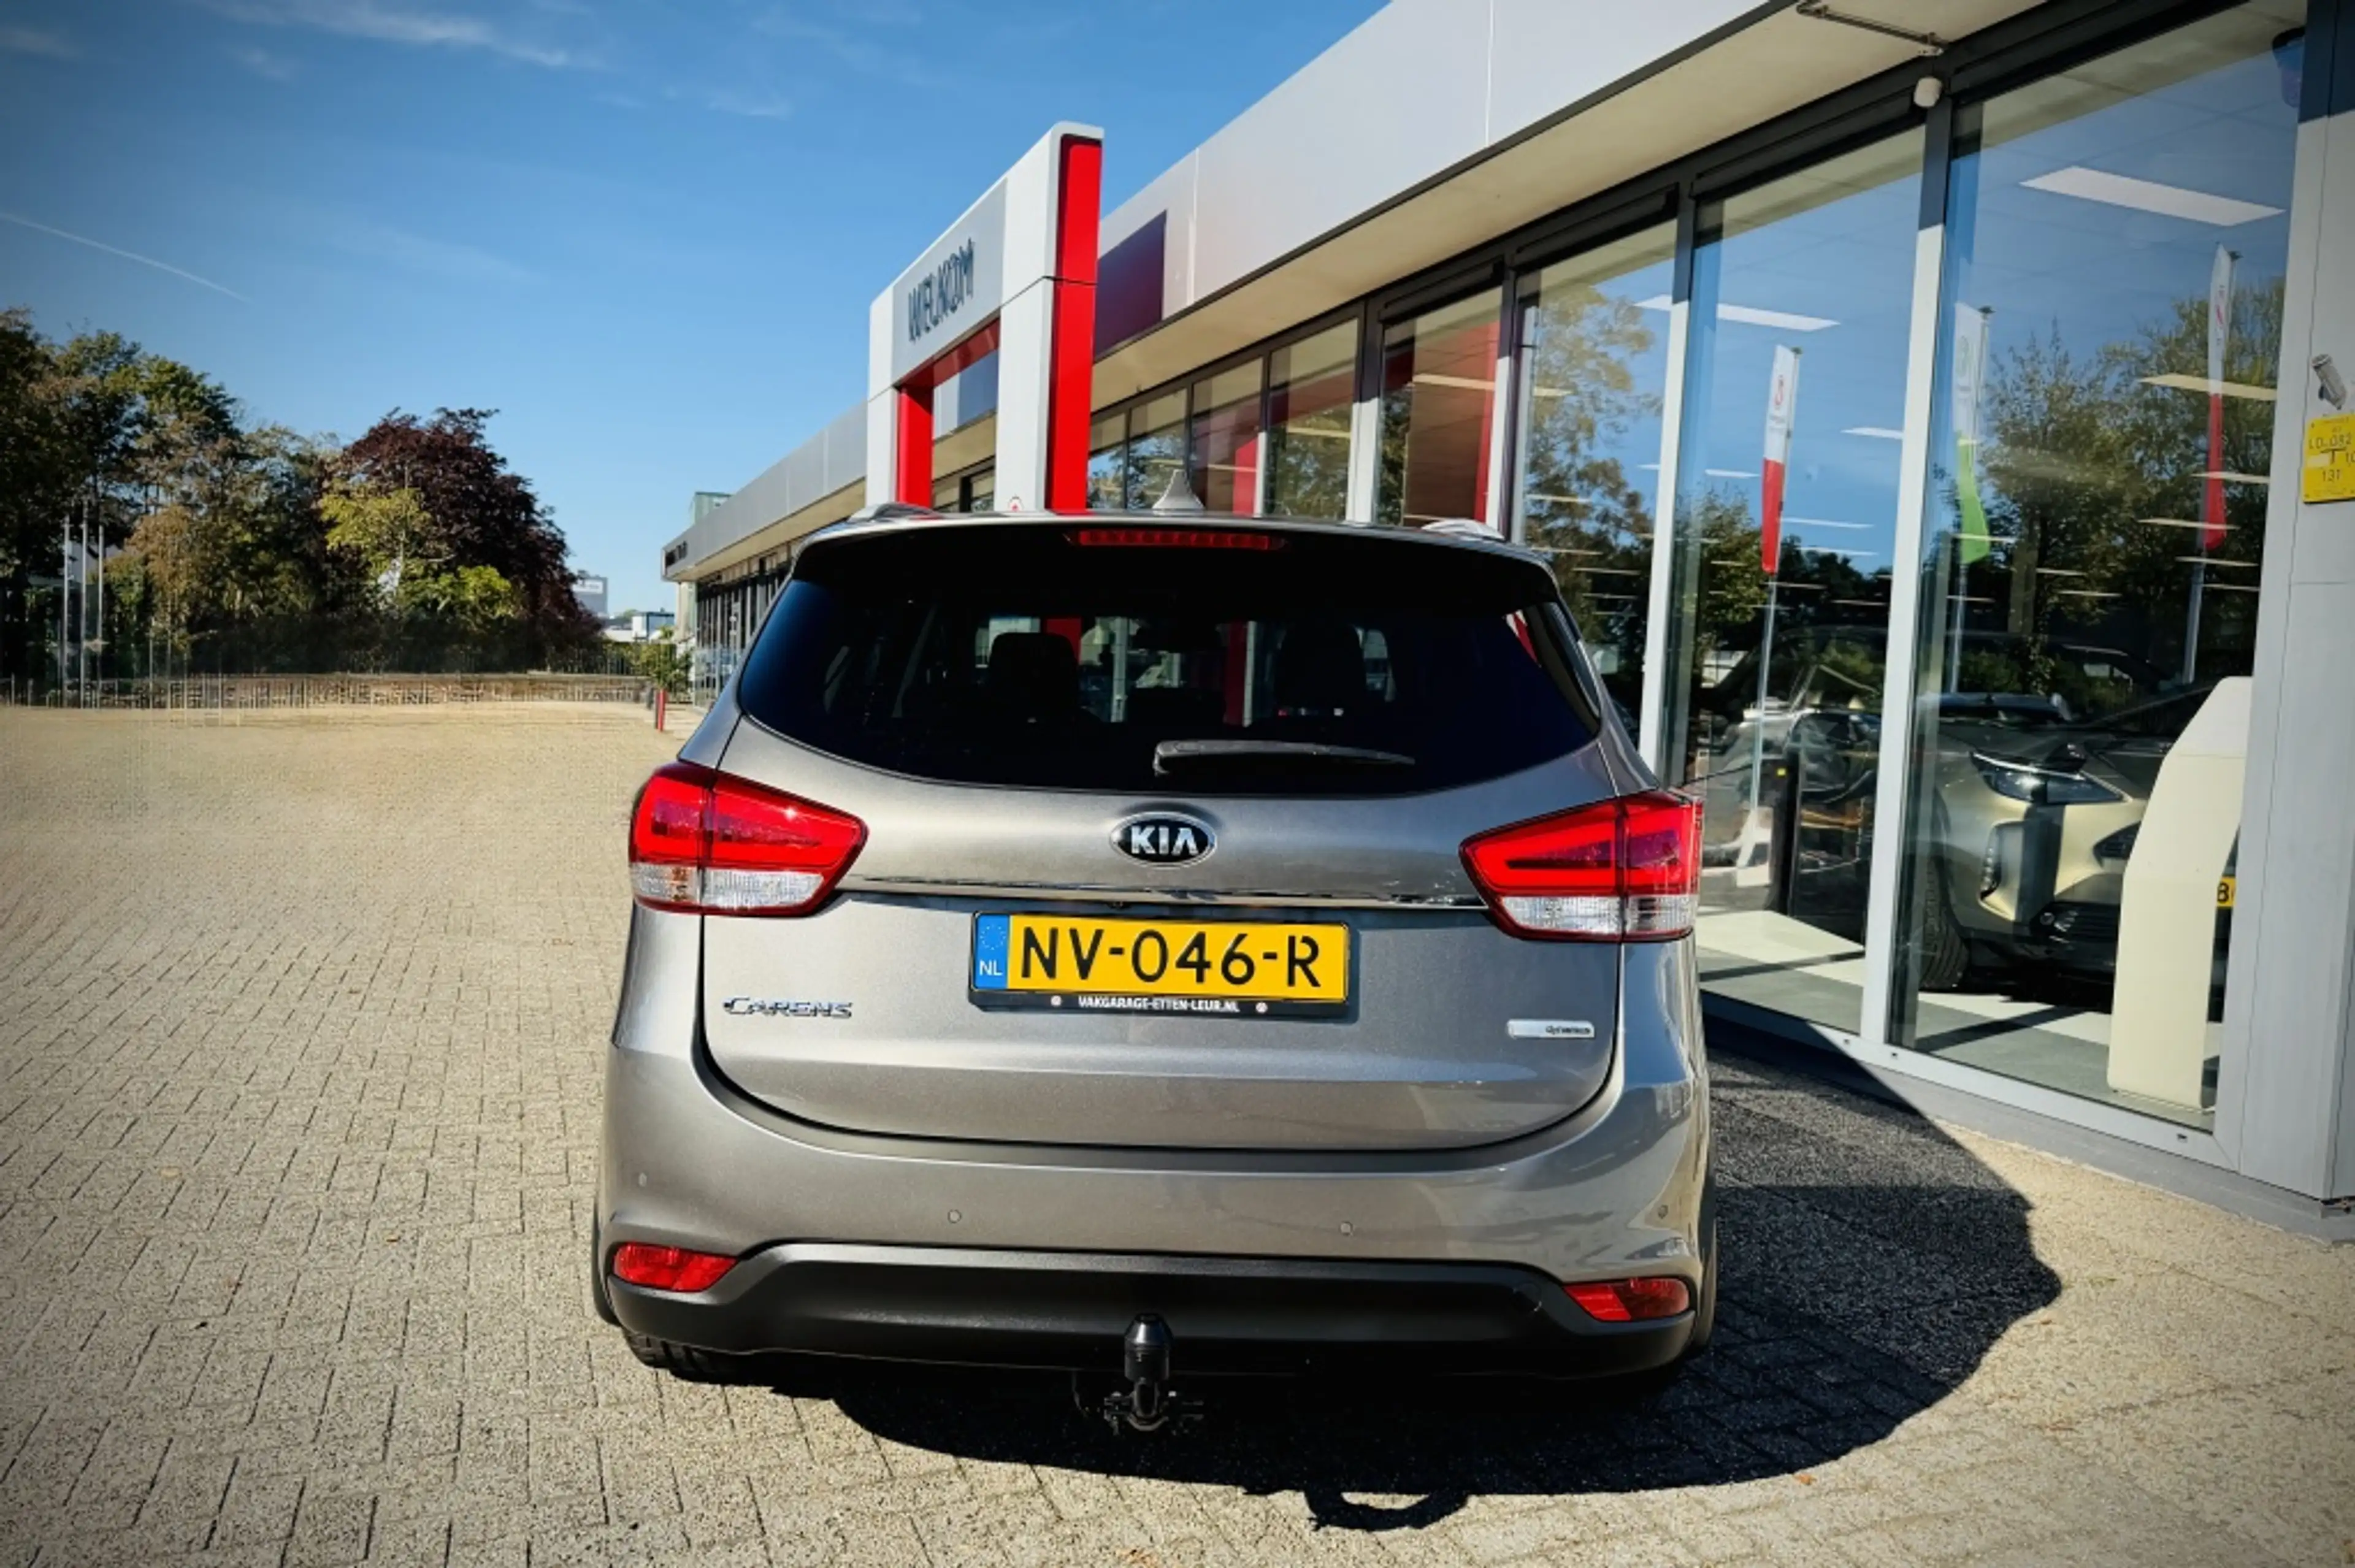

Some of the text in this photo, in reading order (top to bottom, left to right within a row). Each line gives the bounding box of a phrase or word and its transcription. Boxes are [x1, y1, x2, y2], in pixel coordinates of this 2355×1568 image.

[908, 237, 974, 344] WELKOM
[1131, 825, 1198, 855] KIA
[979, 926, 1320, 988] NL NV-046-R
[1078, 995, 1240, 1014] VAKGARAGE-ETTEN-LEUR.NL
